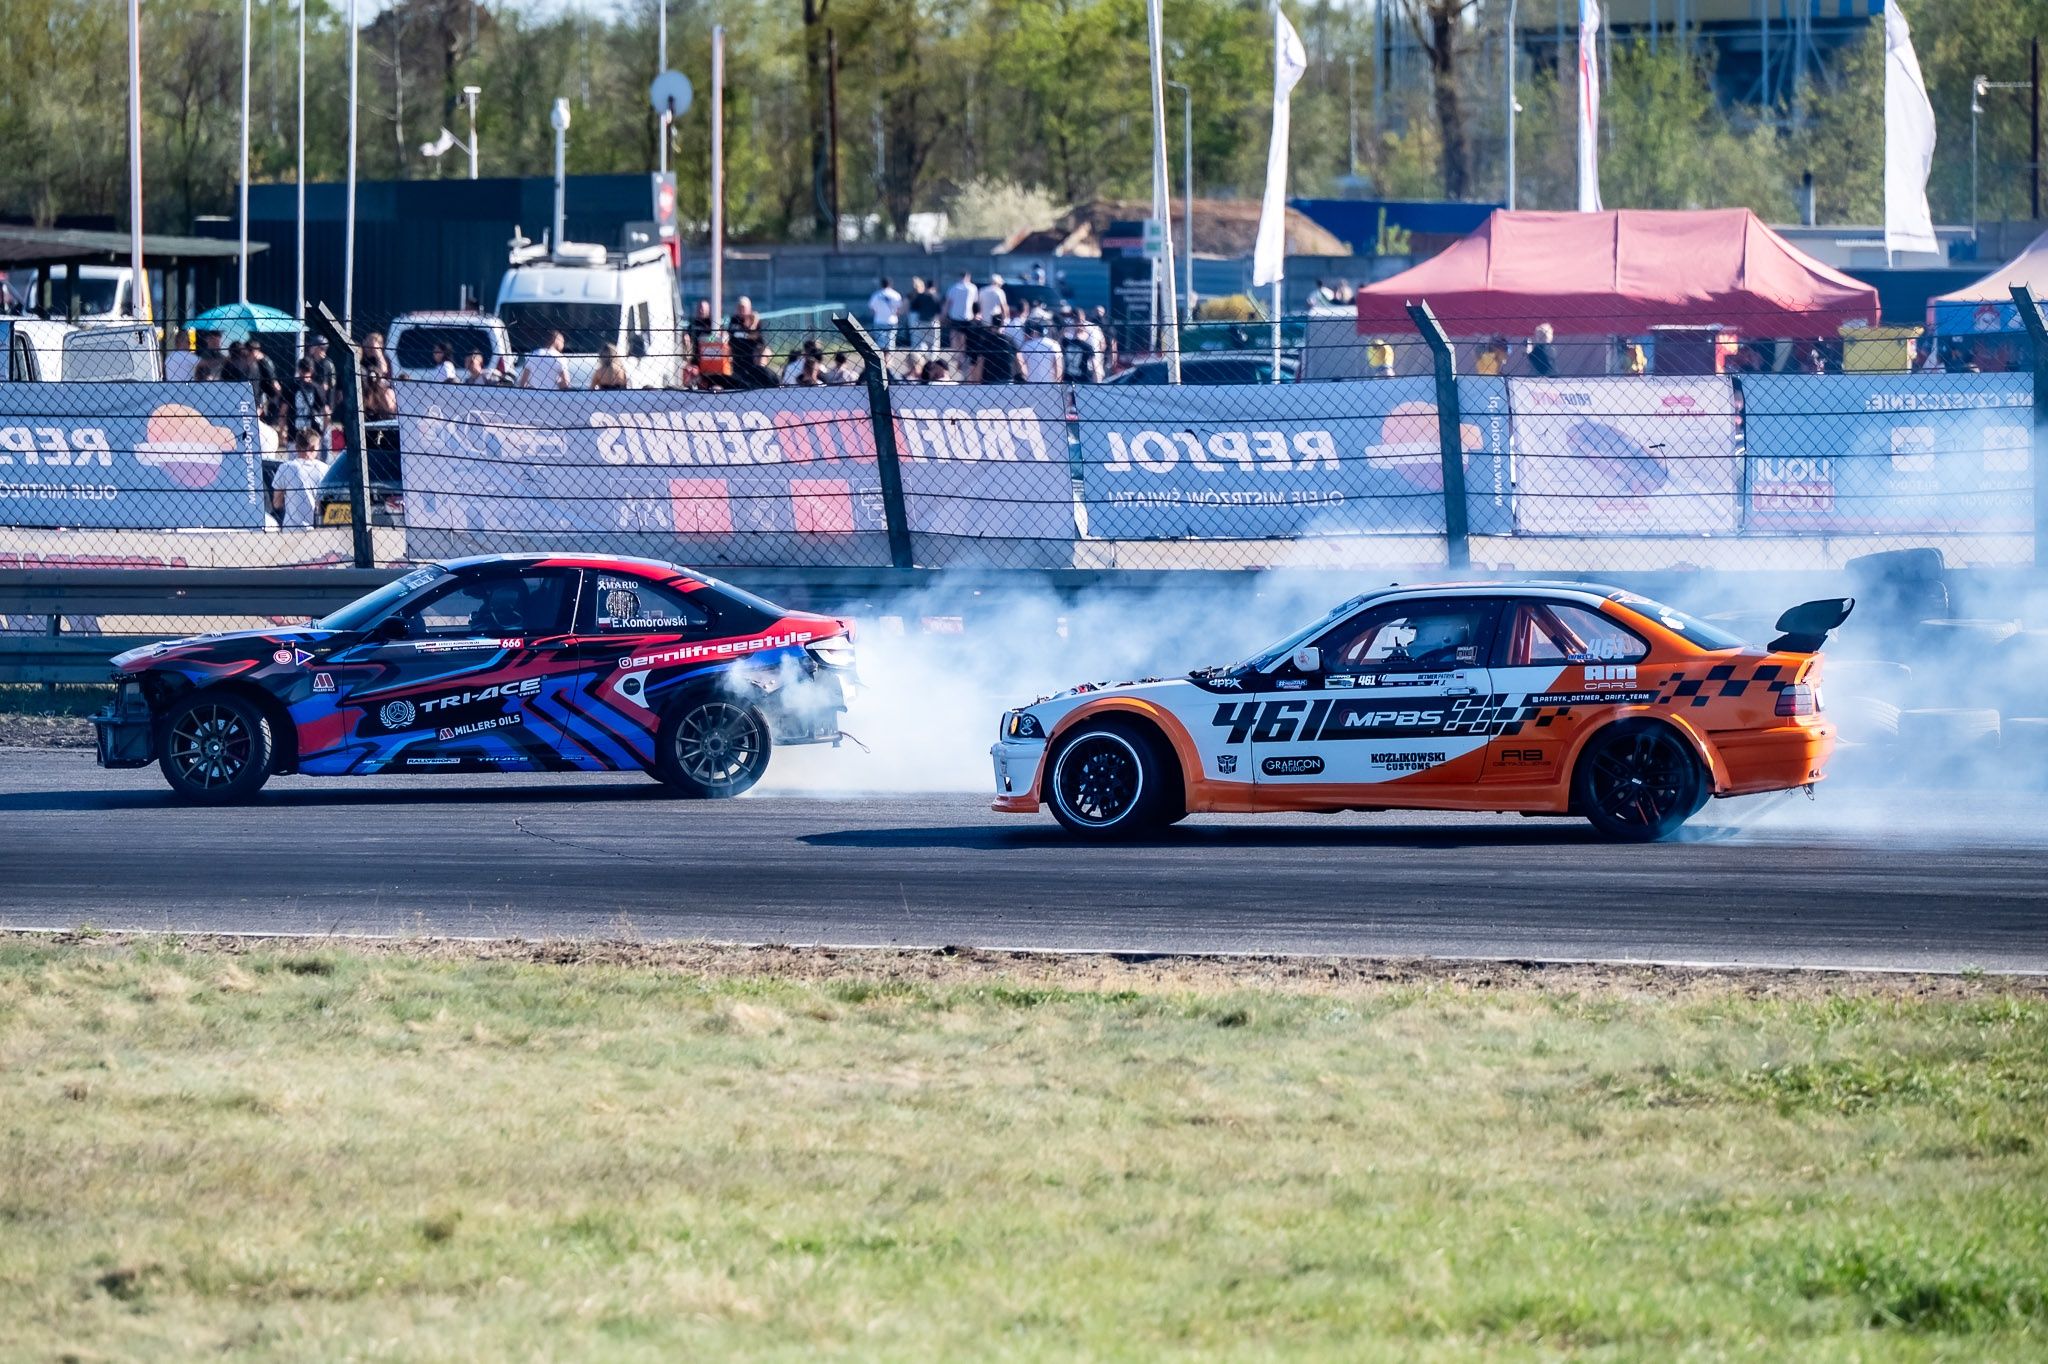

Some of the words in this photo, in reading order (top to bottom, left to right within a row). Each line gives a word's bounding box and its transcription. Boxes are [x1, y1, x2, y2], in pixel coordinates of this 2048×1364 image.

[606, 581, 639, 589] MARIO
[612, 615, 688, 628] E.Komorowski
[501, 638, 521, 648] 666
[1588, 638, 1625, 660] 461
[1584, 665, 1637, 680] AM
[1357, 674, 1376, 686] 461
[1584, 681, 1637, 690] CARS
[419, 677, 541, 713] TRI-ACE
[455, 718, 497, 736] MILLERS
[498, 714, 521, 726] OILS
[1211, 699, 1331, 744] 461
[1344, 710, 1444, 727] MPBS
[1265, 759, 1321, 770] GRAFICON
[1386, 762, 1431, 771] CUSTOMS
